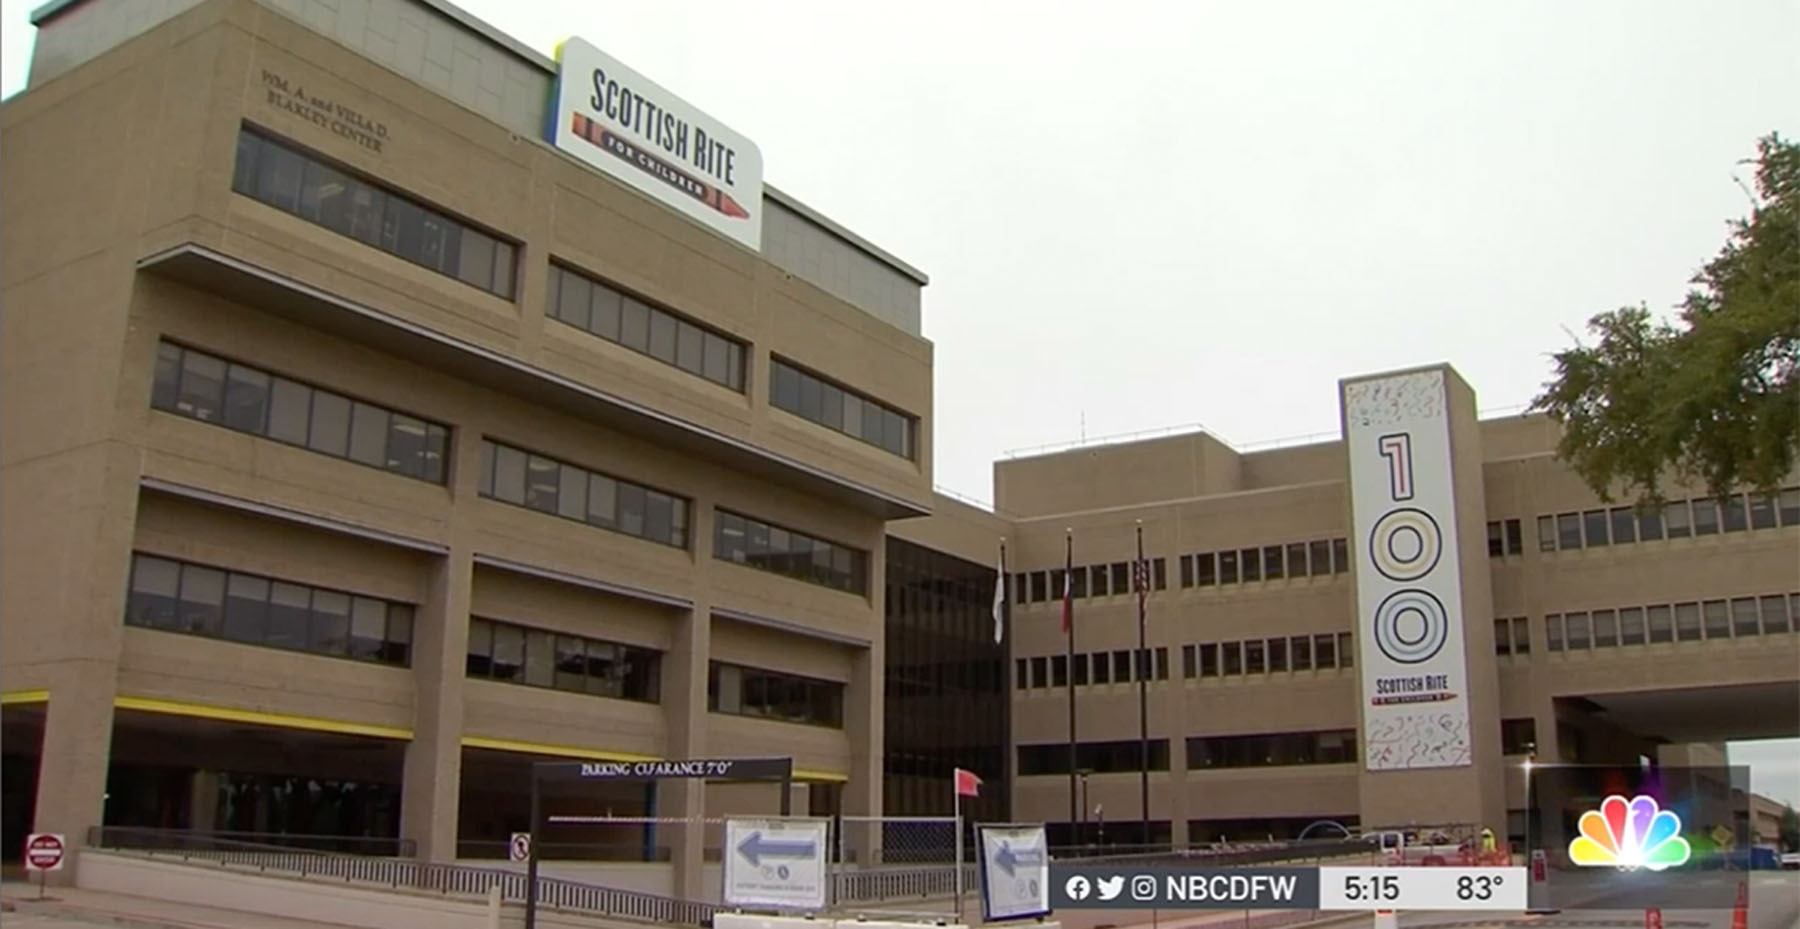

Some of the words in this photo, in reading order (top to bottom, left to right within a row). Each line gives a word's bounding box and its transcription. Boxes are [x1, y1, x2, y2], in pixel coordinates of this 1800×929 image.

[266, 90, 328, 129] BLAKLEY
[331, 120, 383, 153] CENTER
[336, 102, 374, 134] VILLA
[590, 67, 688, 161] SCOTTISH
[693, 124, 736, 187] RITE
[607, 136, 634, 158] FOR
[638, 153, 704, 196] CHILDREN
[1376, 678, 1423, 694] SCOTTISH
[1425, 675, 1448, 691] RITE
[581, 762, 630, 776] PARKING
